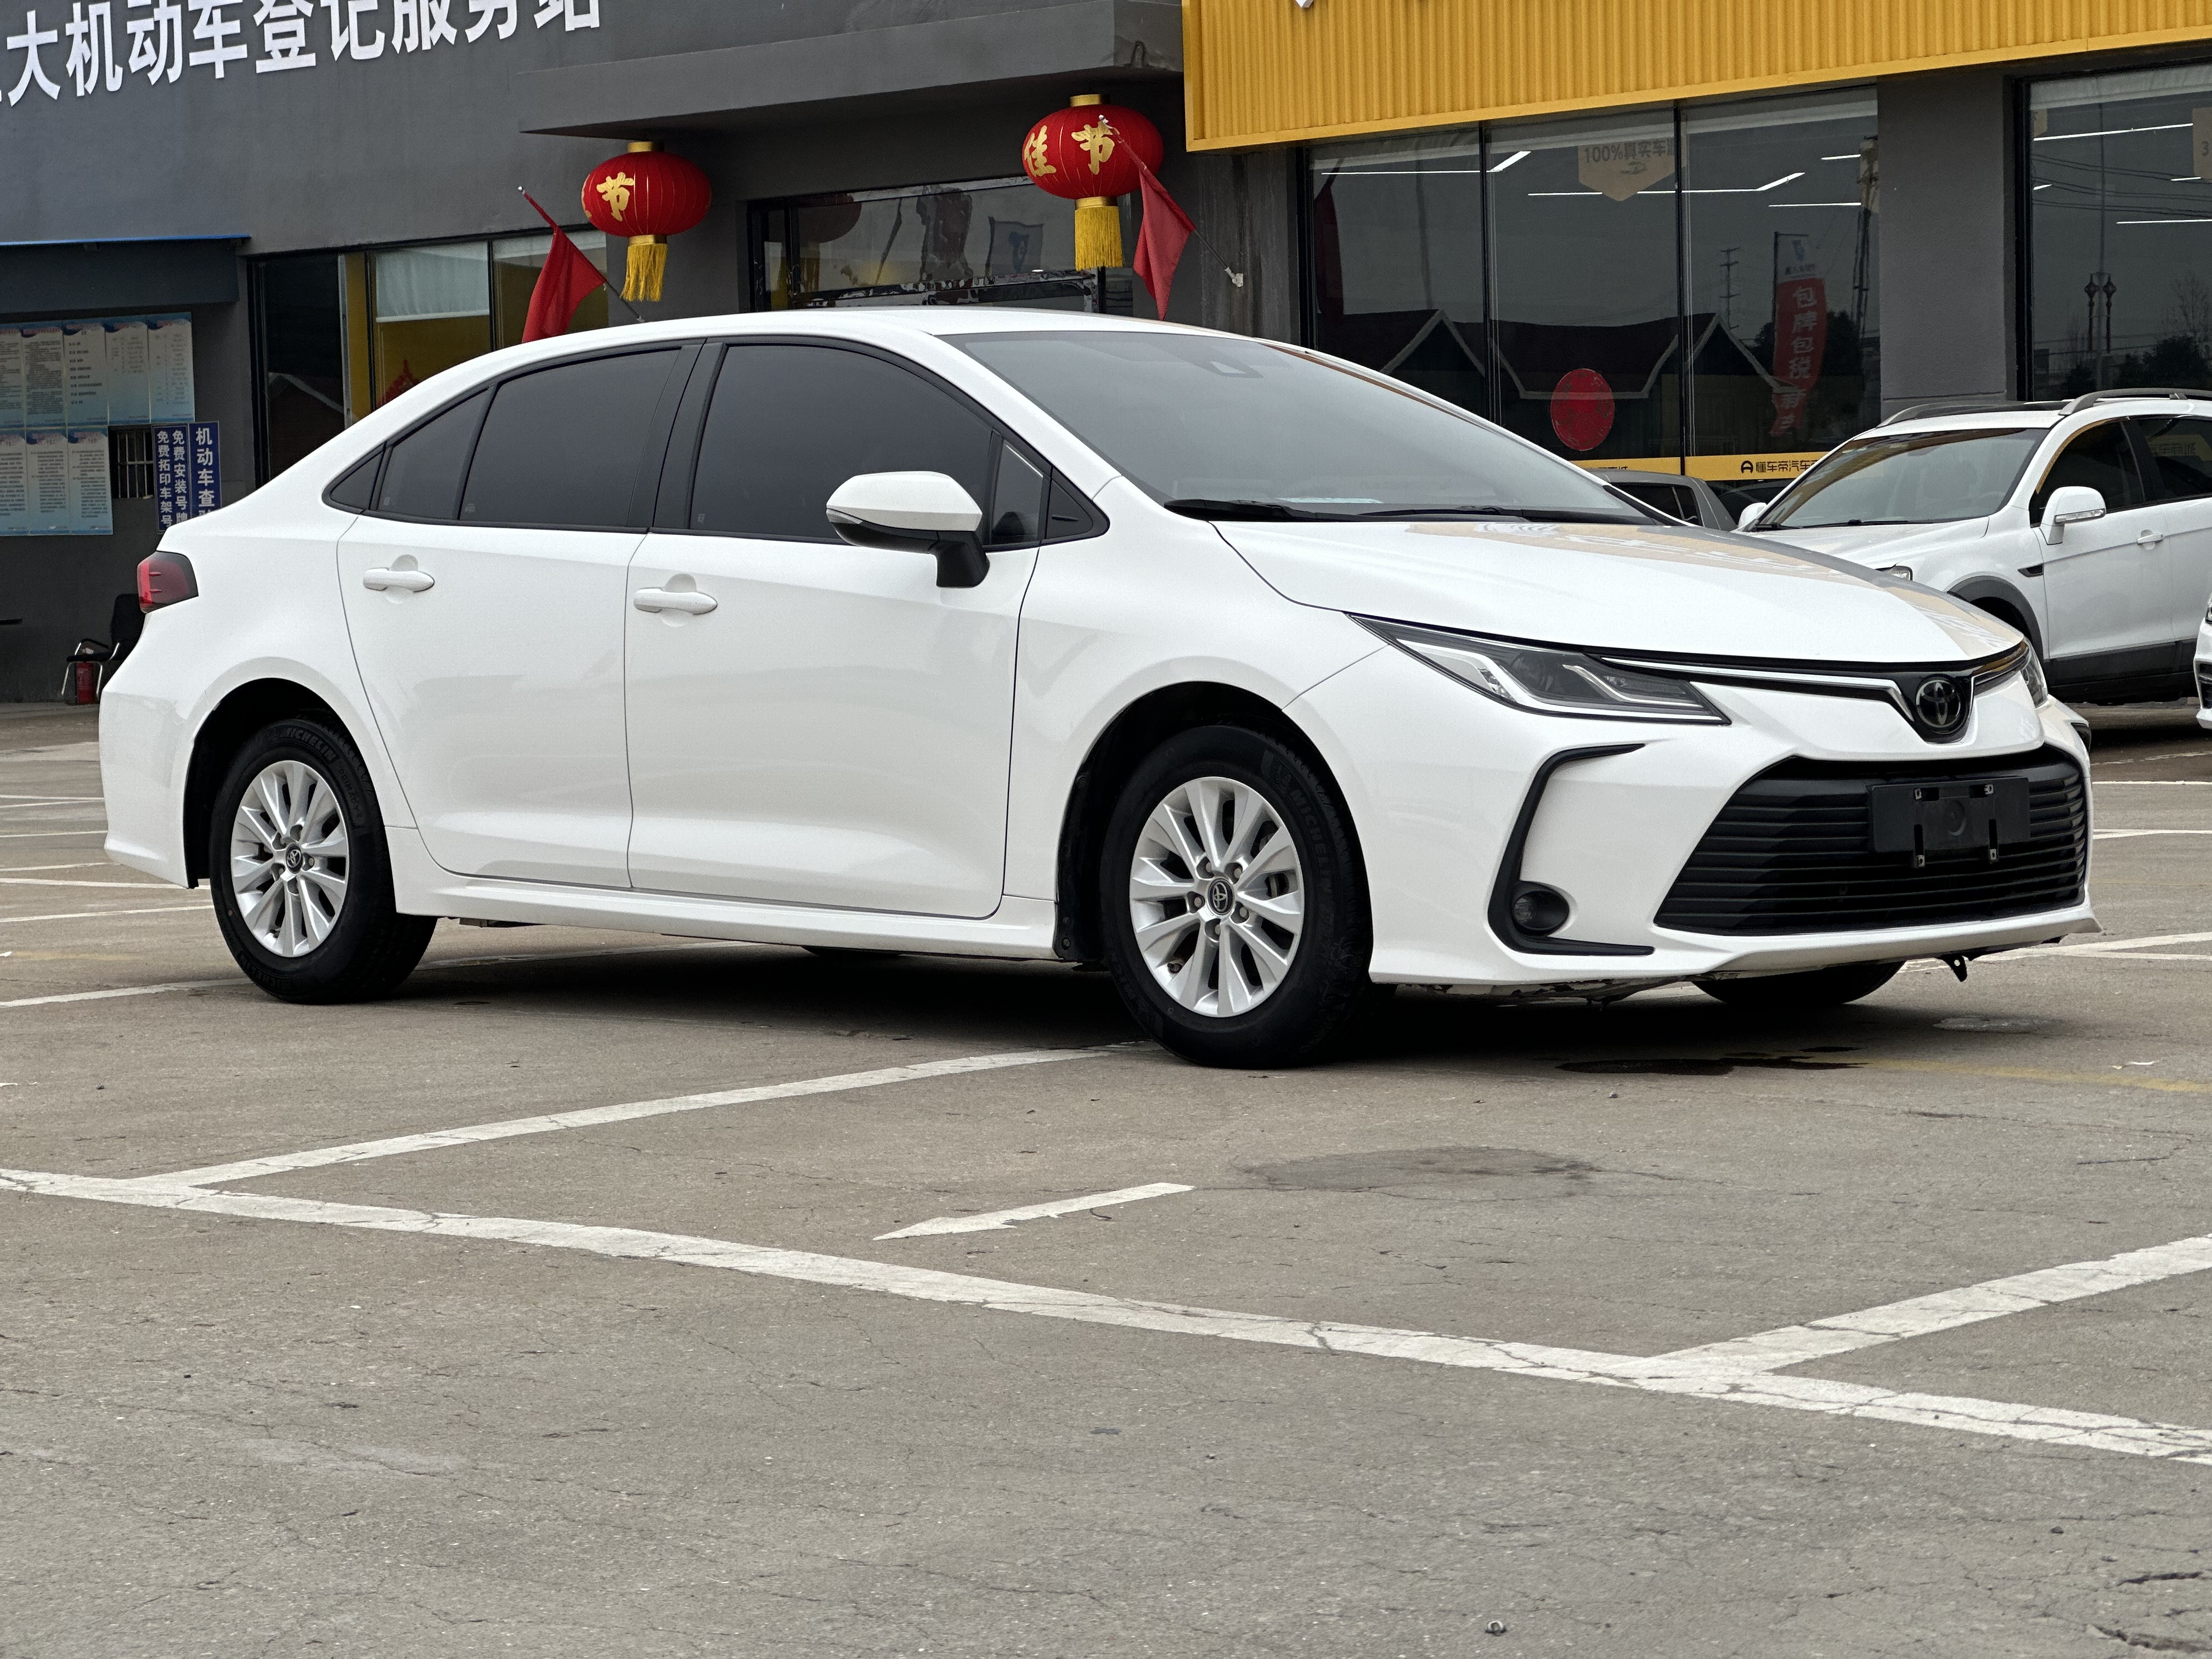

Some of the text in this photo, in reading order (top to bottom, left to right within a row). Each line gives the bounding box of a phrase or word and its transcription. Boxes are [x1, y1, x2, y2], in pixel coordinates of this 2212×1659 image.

[0, 0, 600, 106] 大机动车登记服务
[596, 172, 635, 222] 节
[157, 431, 173, 527] 免费拓印车架号
[172, 430, 188, 523] 免费安装号牌
[1756, 459, 1818, 473] 懂车帝汽车
